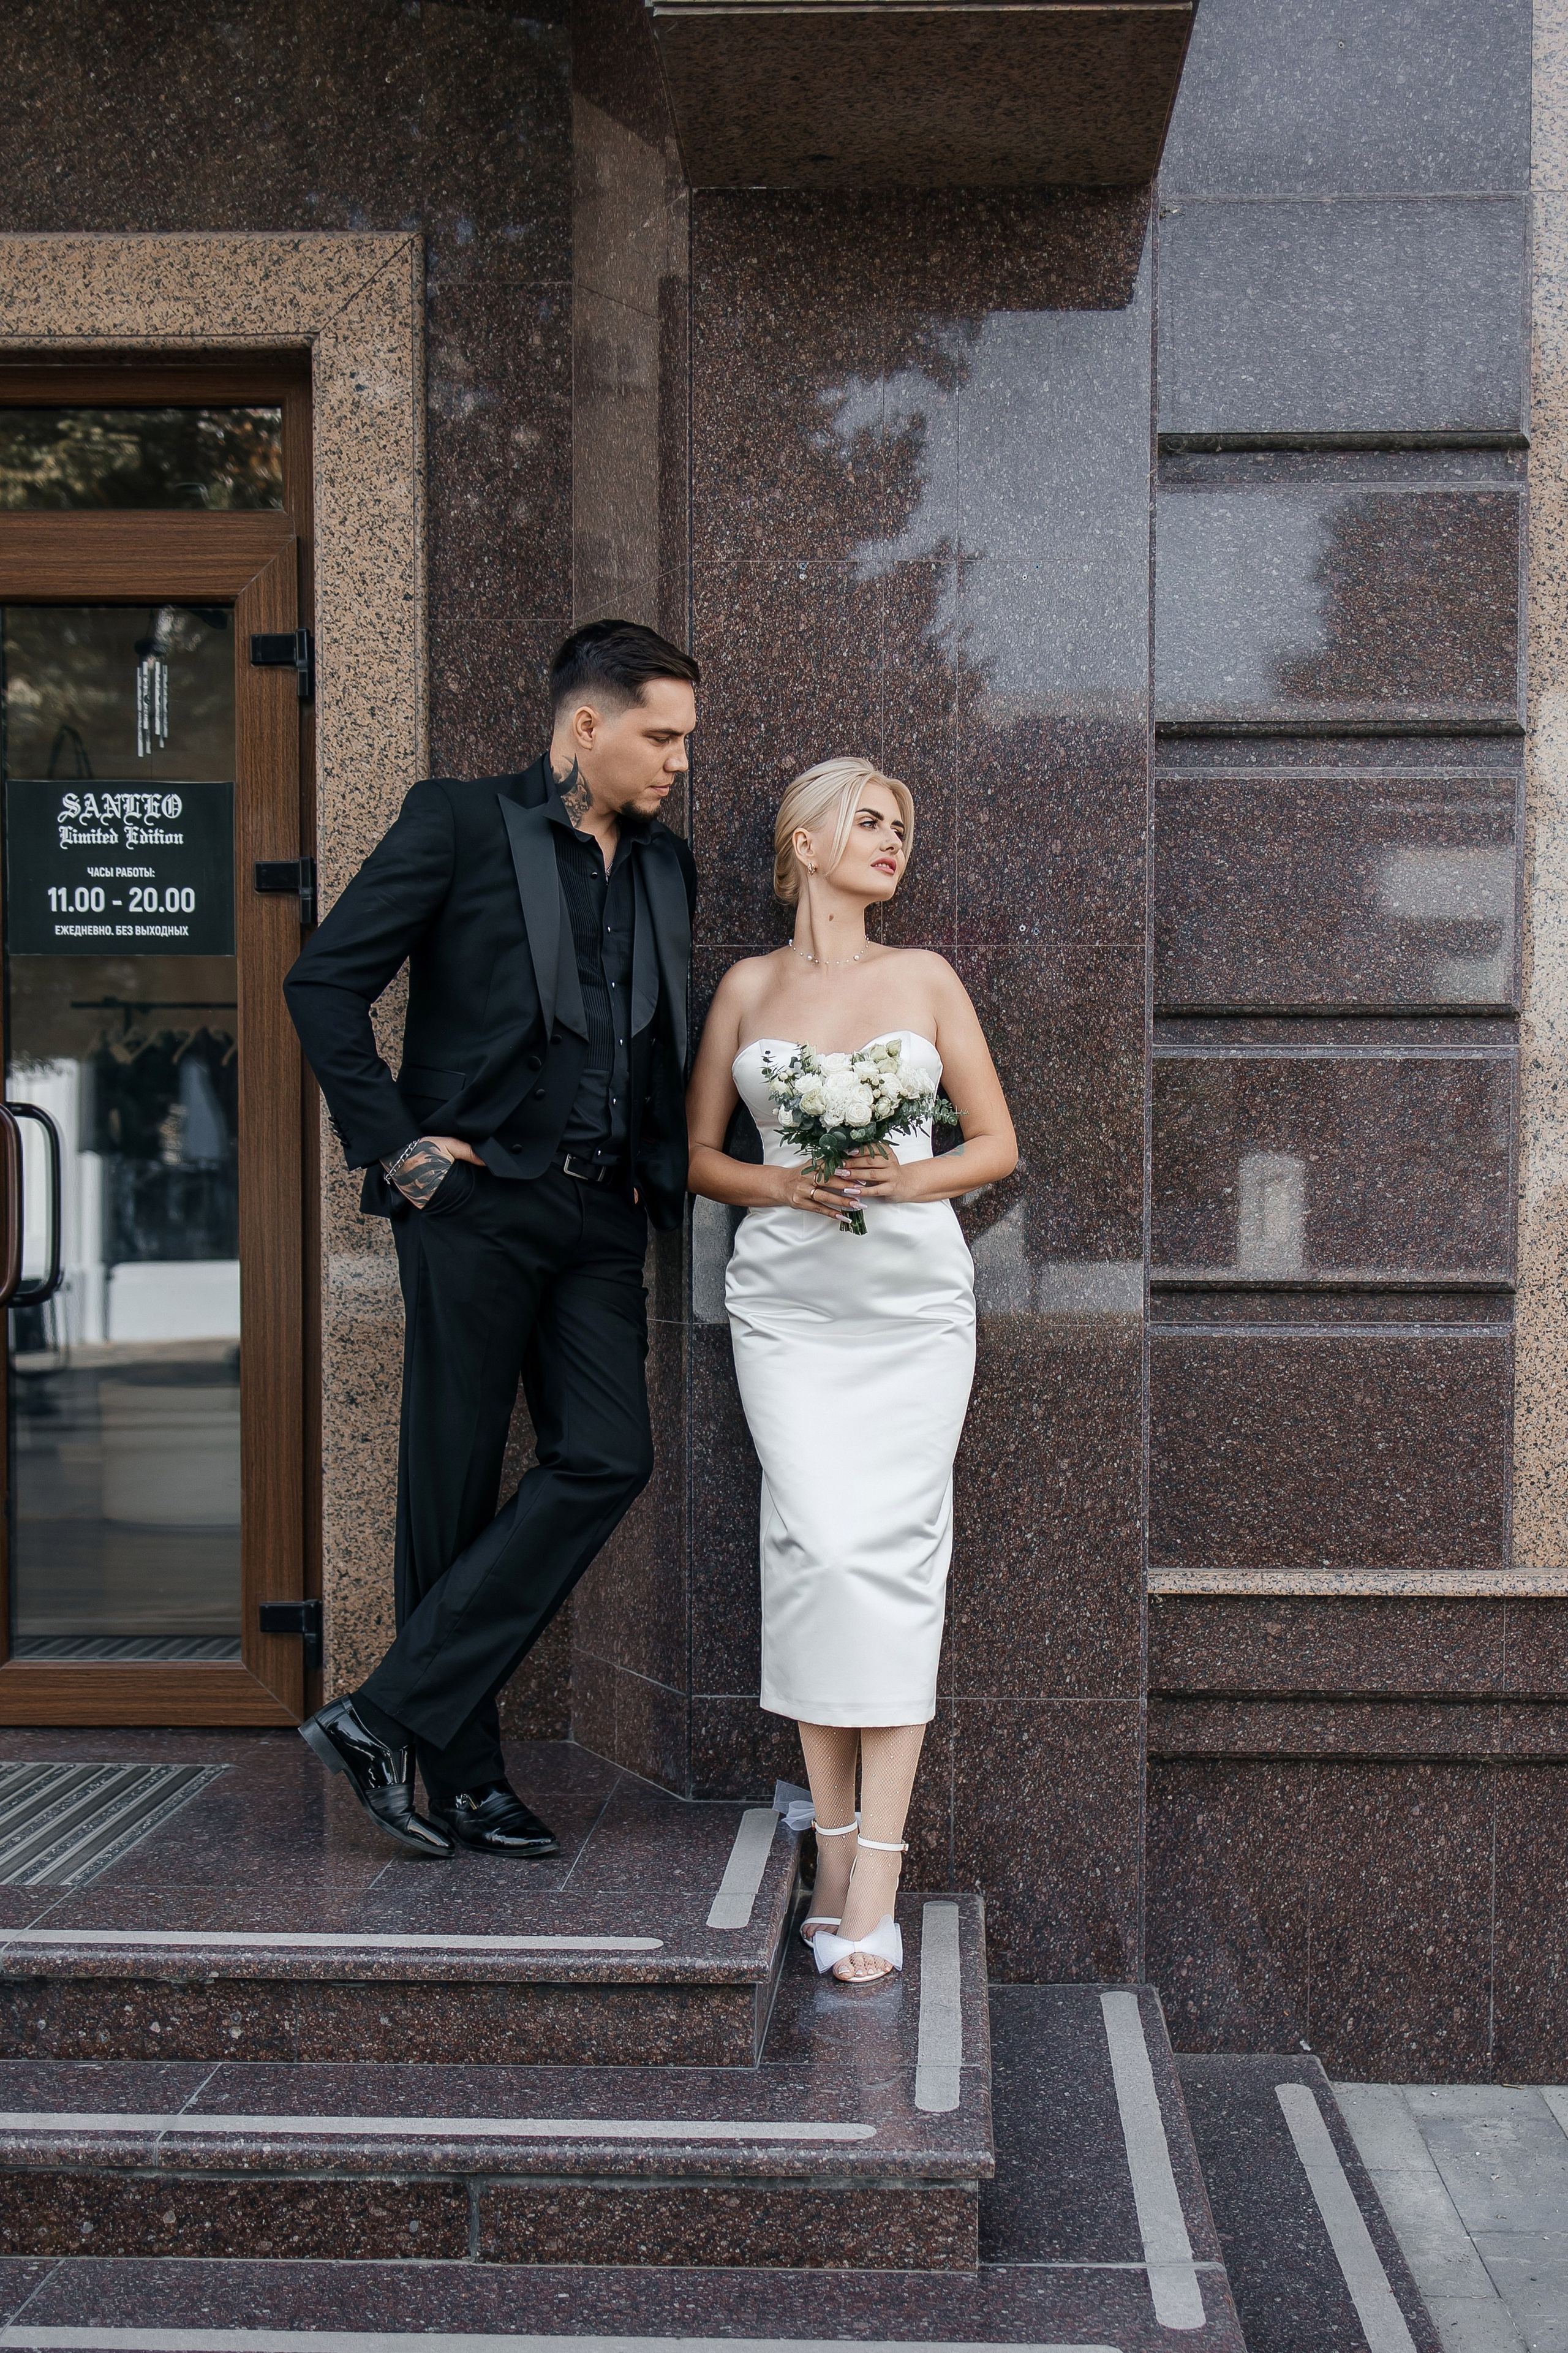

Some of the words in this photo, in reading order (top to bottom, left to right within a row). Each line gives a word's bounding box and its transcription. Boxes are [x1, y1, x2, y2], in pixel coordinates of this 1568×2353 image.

[58, 793, 183, 826] SANLEO
[59, 826, 119, 850] Limited
[124, 826, 184, 850] Edition
[87, 867, 114, 877] ЧАСЫ
[116, 867, 156, 878] РАБОТЫ:
[48, 887, 105, 913] 11.00
[129, 887, 195, 913] 20.00
[55, 925, 115, 937] ЕЖЕДНЕВНО.
[116, 926, 134, 936] БЕЗ
[135, 926, 189, 937] ВЫХОДНЫХ
